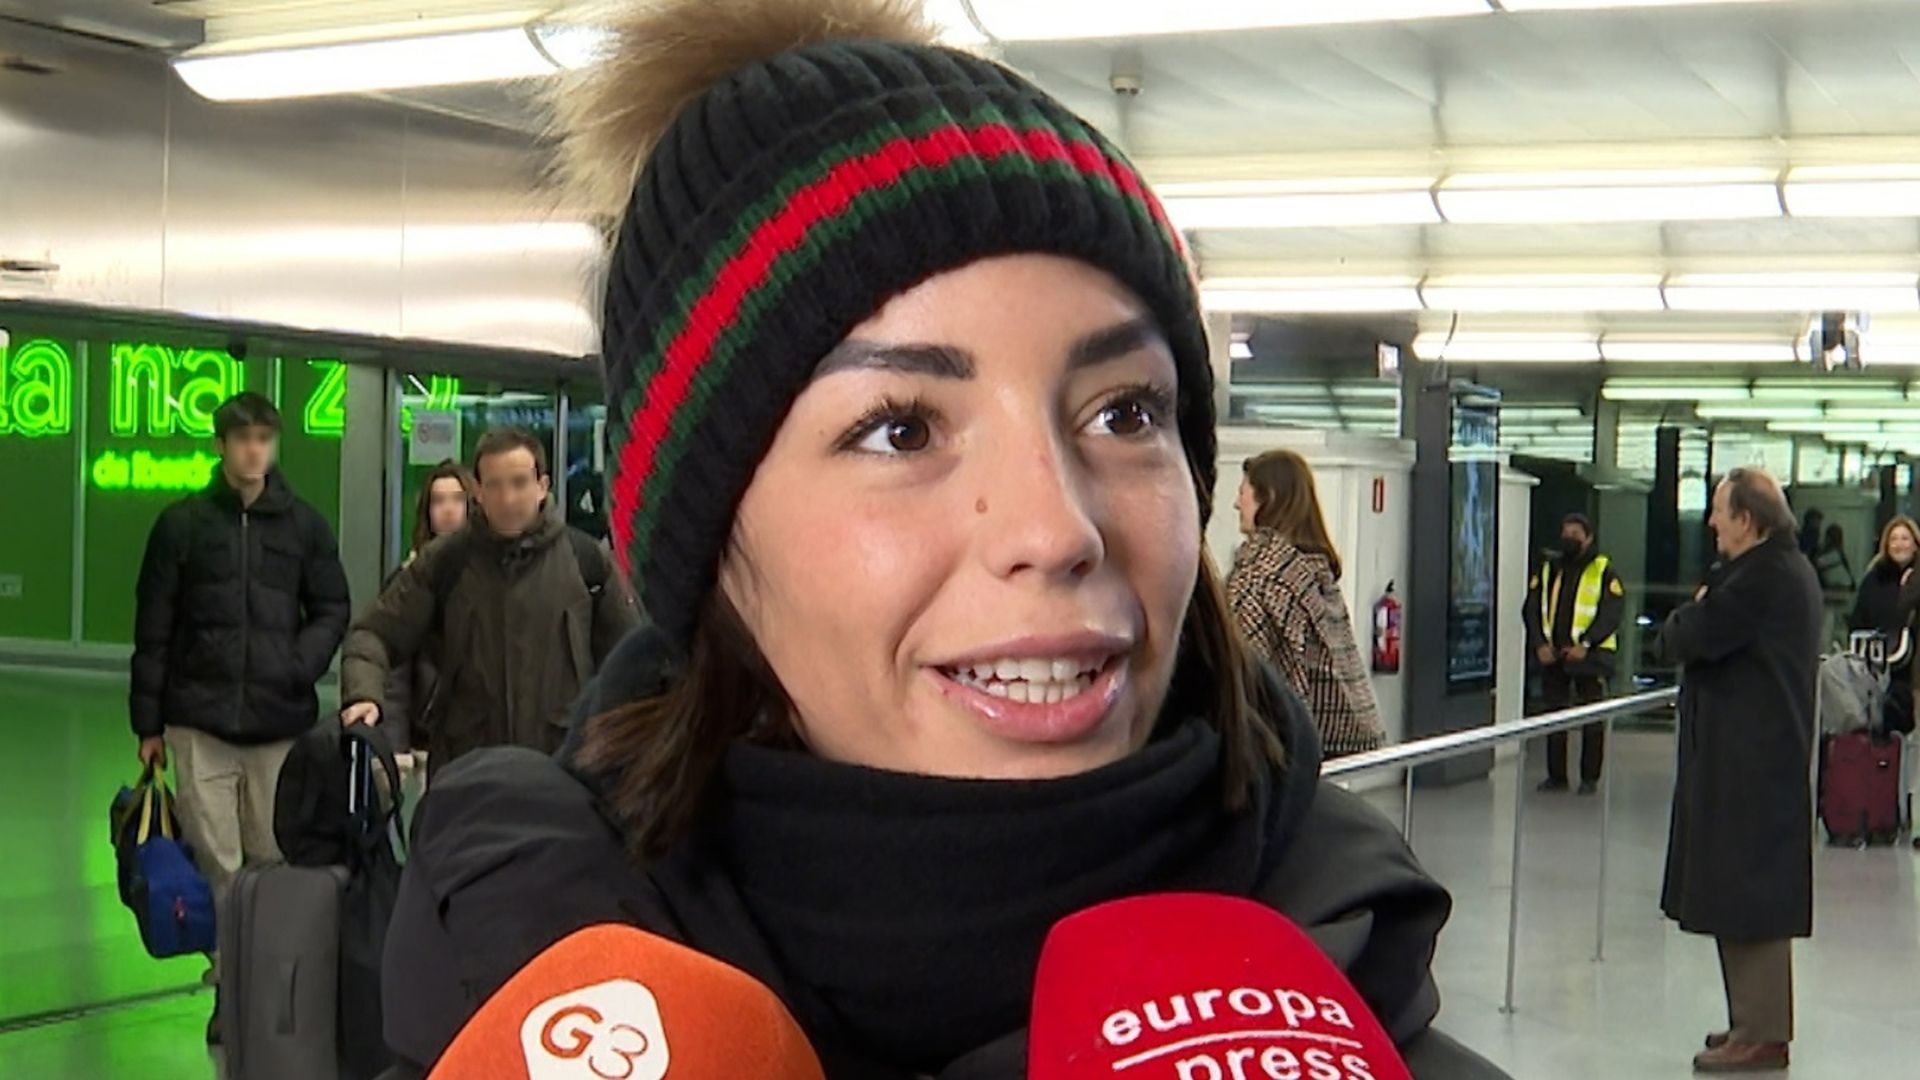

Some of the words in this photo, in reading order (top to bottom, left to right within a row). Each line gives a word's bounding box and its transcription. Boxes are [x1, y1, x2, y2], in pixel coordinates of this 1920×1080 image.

[541, 1004, 648, 1080] G3
[1102, 986, 1354, 1046] europa
[1175, 1046, 1376, 1080] press
